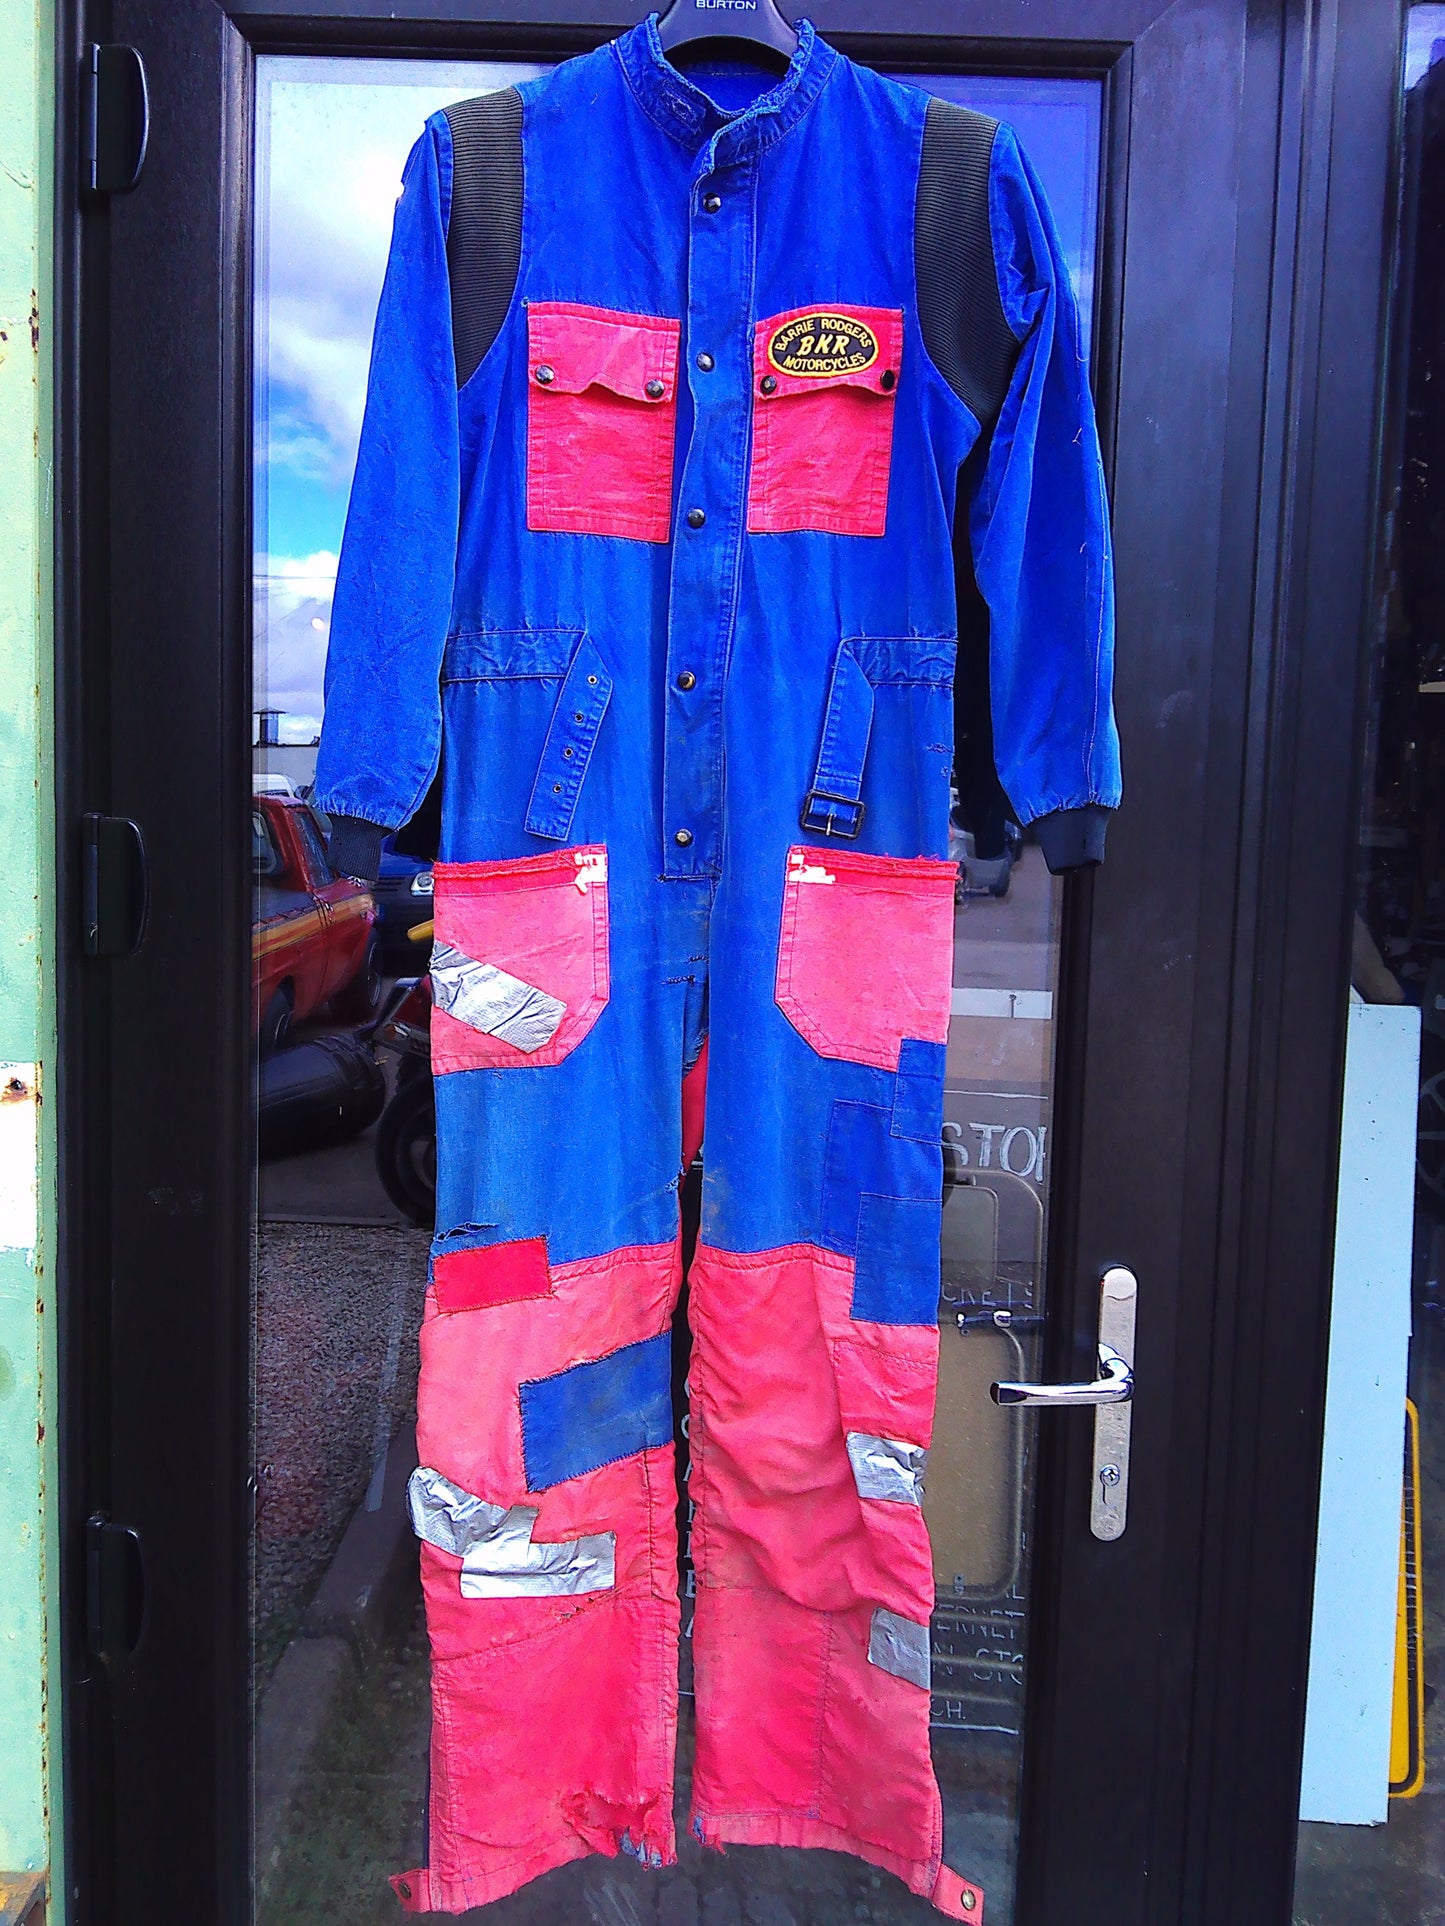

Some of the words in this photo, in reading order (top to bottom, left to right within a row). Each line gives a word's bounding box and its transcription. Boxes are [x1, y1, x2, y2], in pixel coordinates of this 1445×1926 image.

[696, 0, 757, 10] BURTON
[774, 319, 815, 351] BARRIE
[821, 318, 872, 348] RODGERS
[796, 333, 850, 356] BKR
[782, 352, 866, 371] MOTORCYCLES
